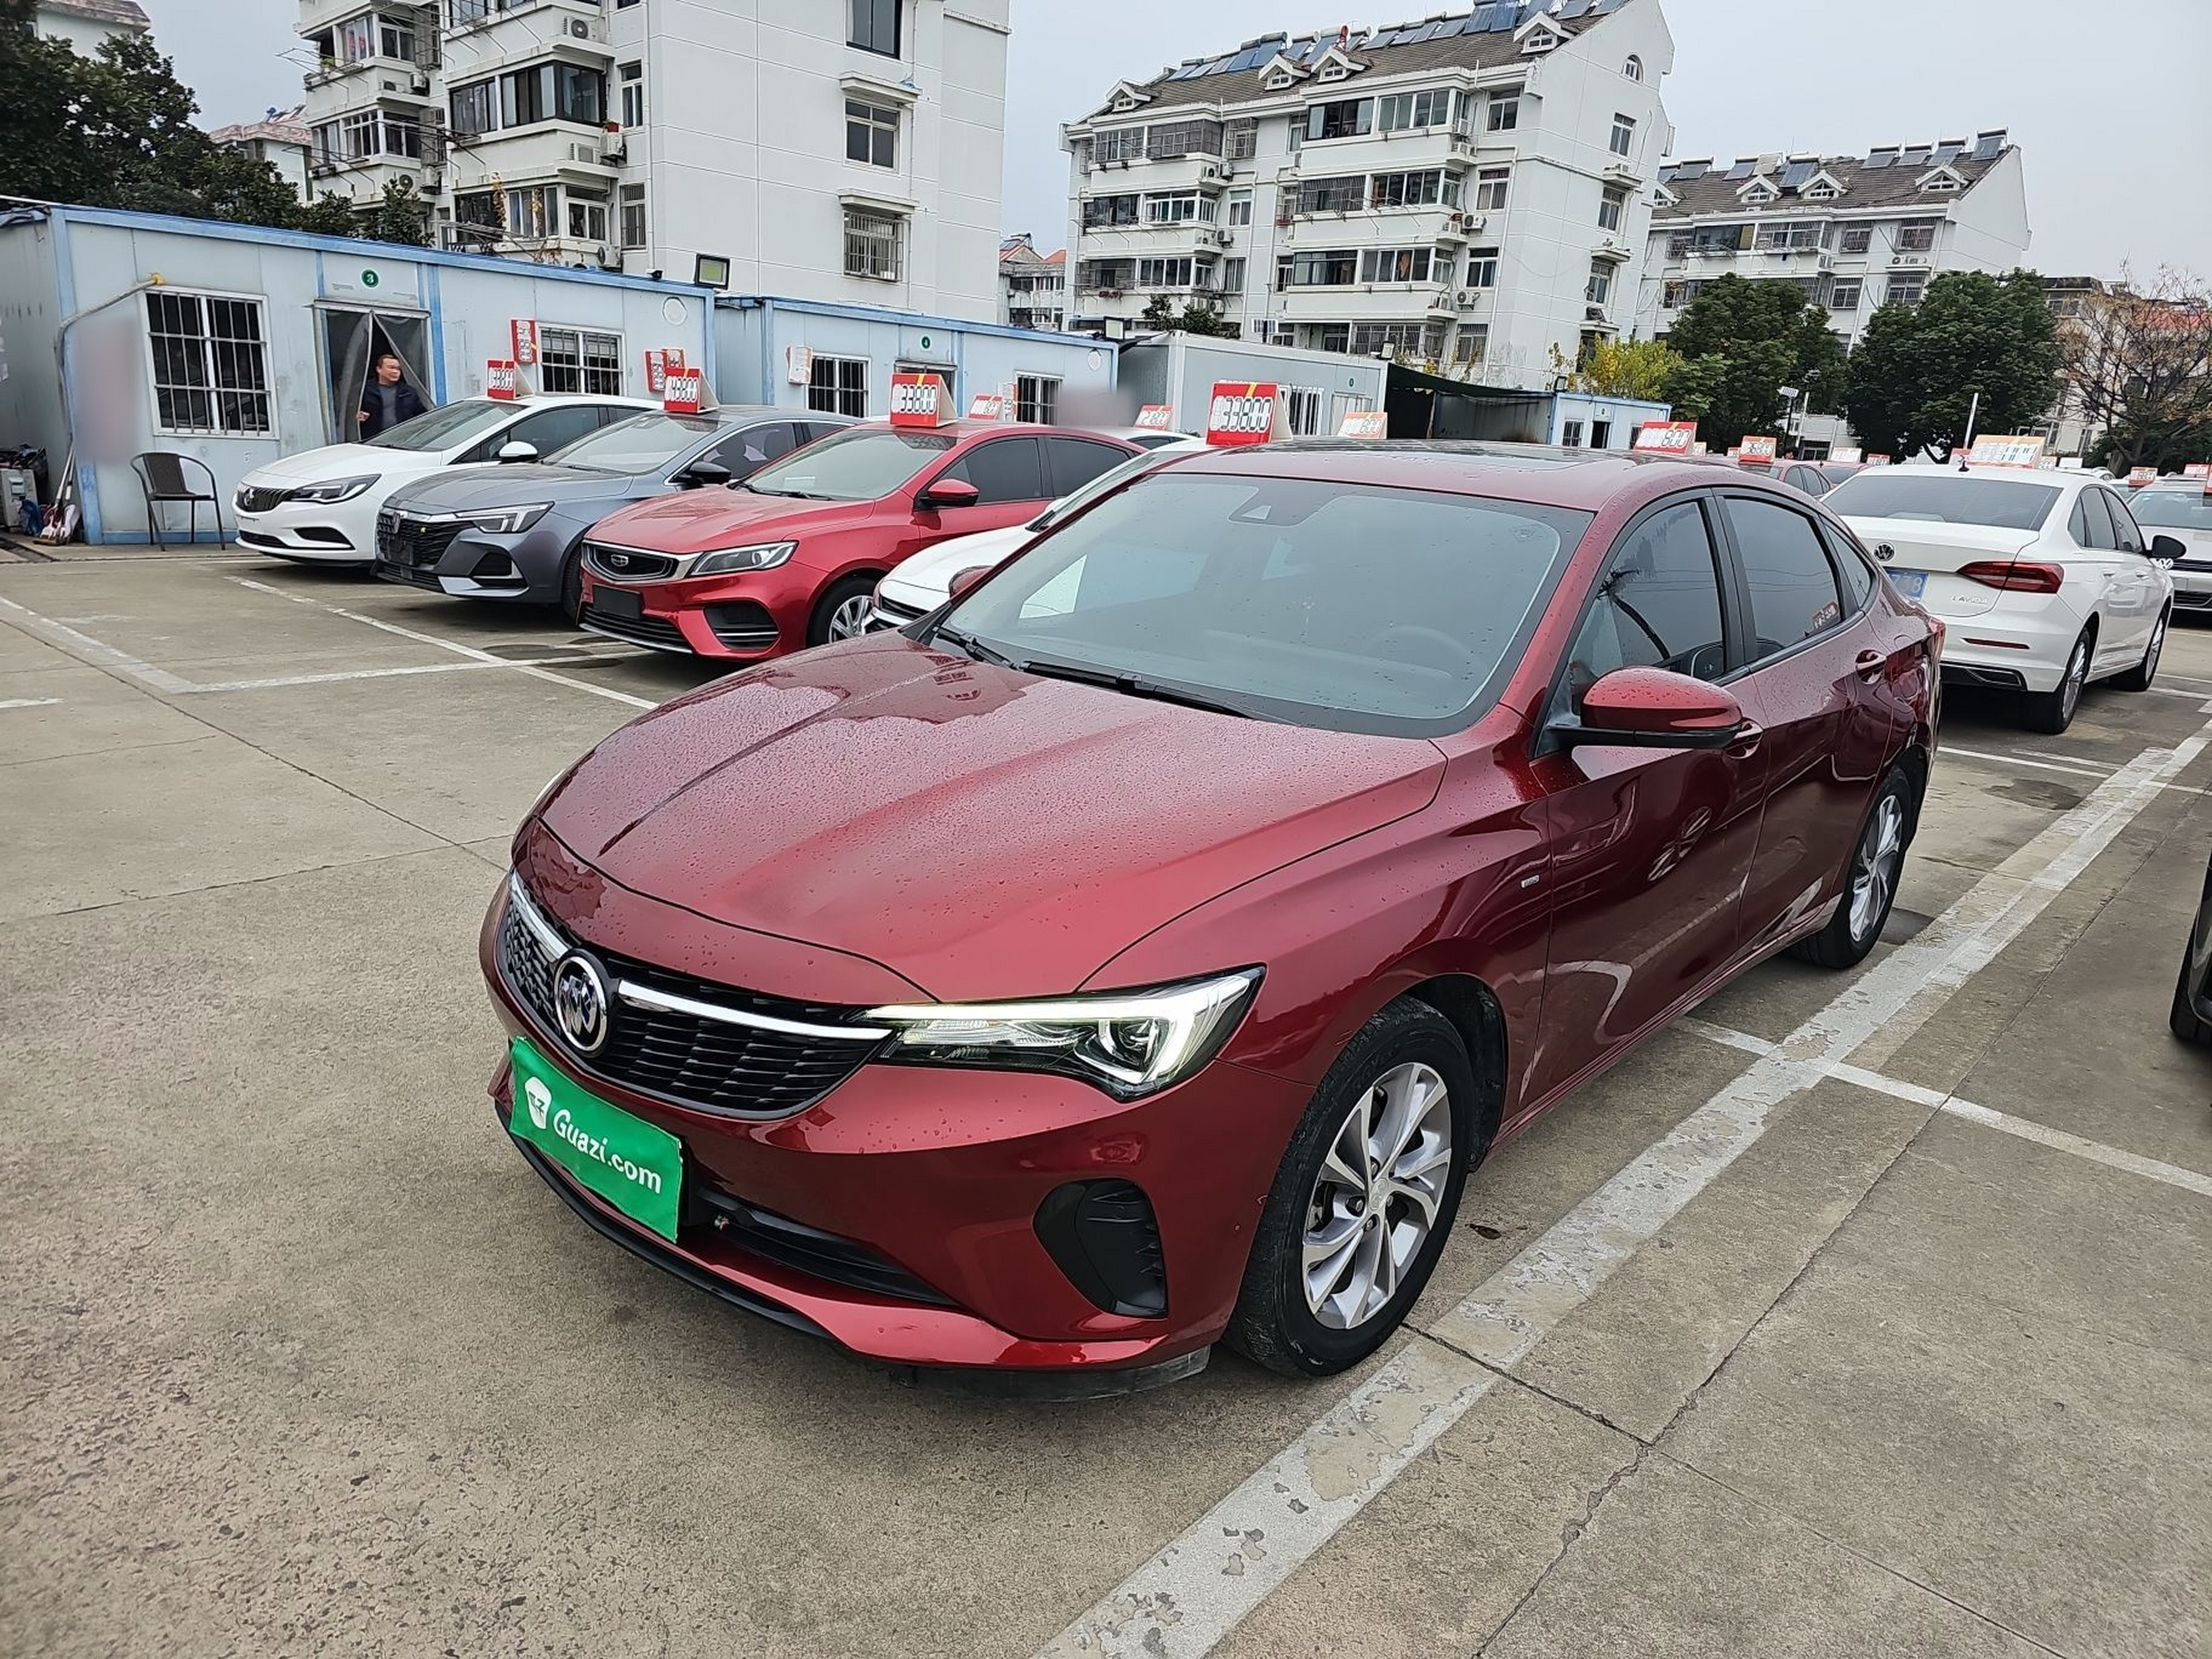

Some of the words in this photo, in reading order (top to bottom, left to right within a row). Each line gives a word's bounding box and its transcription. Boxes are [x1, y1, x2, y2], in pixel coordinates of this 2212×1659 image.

[367, 274, 374, 284] 3
[900, 385, 938, 412] 33800
[1221, 397, 1271, 431] 33800
[553, 1109, 662, 1194] Guazi.com
